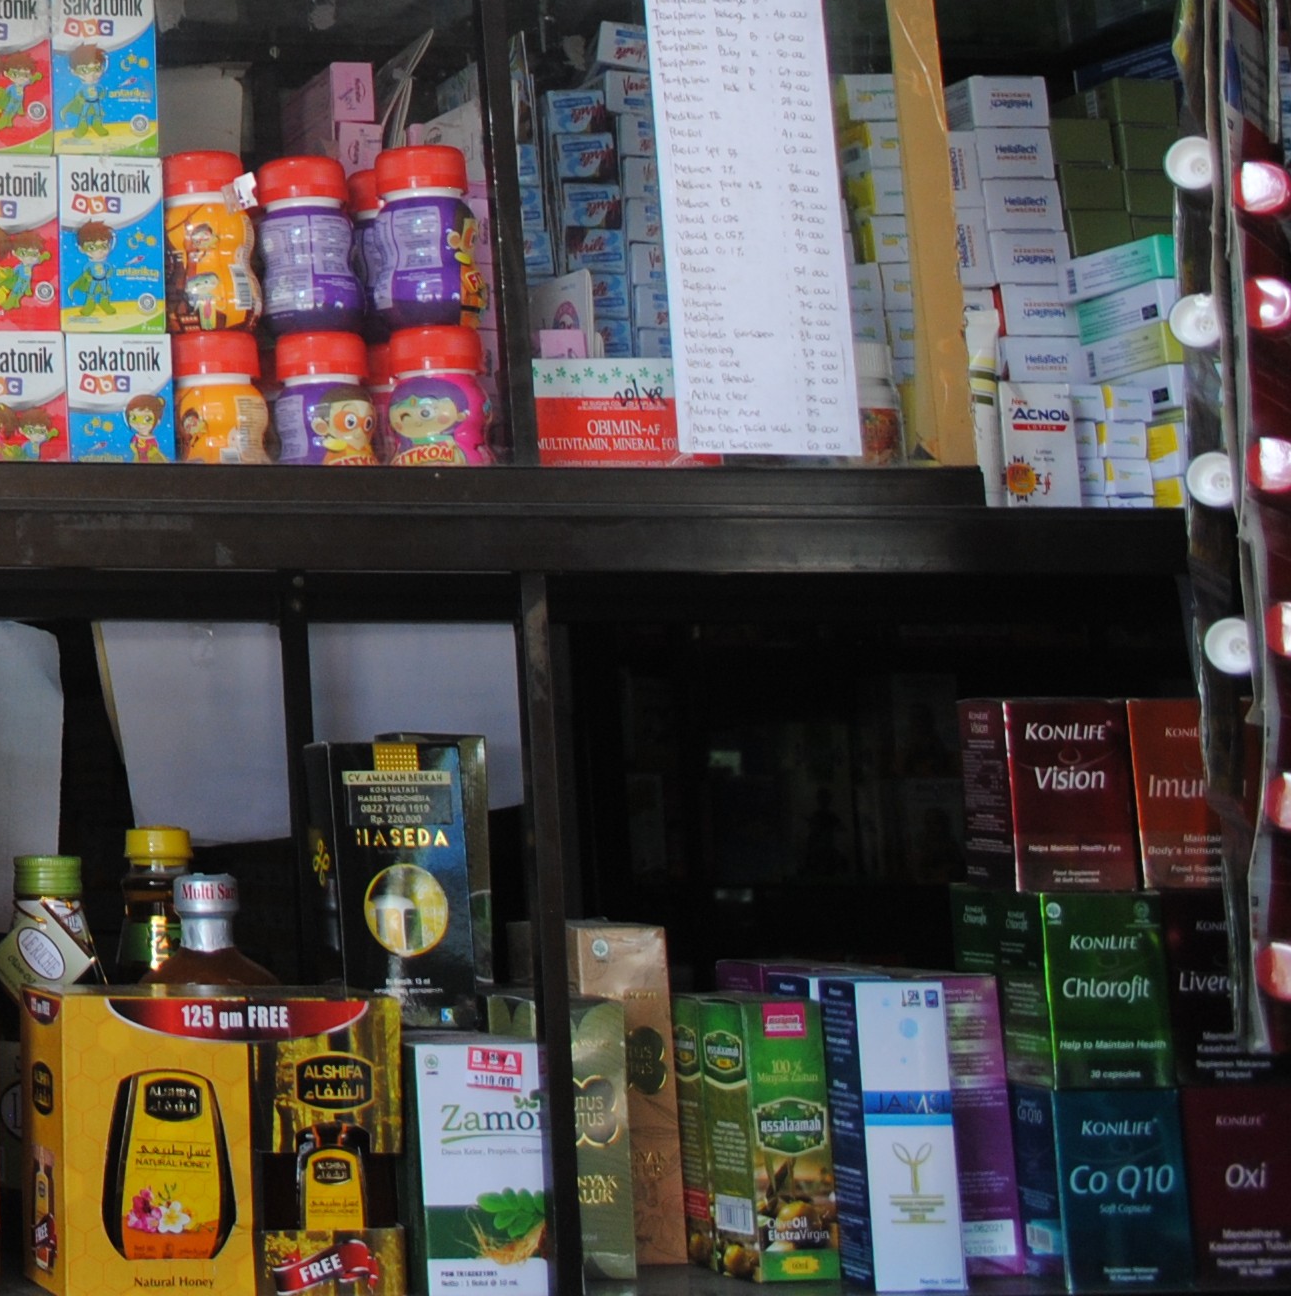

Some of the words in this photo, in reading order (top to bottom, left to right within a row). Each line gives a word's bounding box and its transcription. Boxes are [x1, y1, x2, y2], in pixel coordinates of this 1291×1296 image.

[366, 773, 406, 782] AMANAH
[408, 773, 443, 781] BERKAH
[1033, 766, 1106, 790] Vision
[356, 828, 449, 847] HASEDA
[181, 883, 213, 900] Multi
[1062, 978, 1151, 1006] Chlorofit
[181, 1004, 214, 1027] 125
[219, 1008, 244, 1030] gm
[248, 1005, 290, 1029] FREE
[304, 1065, 363, 1079] ALSHIFA
[135, 1157, 175, 1168] NATURAL
[179, 1158, 212, 1169] HONEY
[1068, 1166, 1109, 1195] Co
[1117, 1165, 1174, 1198] Q10
[1225, 1163, 1267, 1189] Oxi
[299, 1253, 343, 1282] FREE
[134, 1275, 176, 1288] Natural
[179, 1276, 215, 1289] Honey
